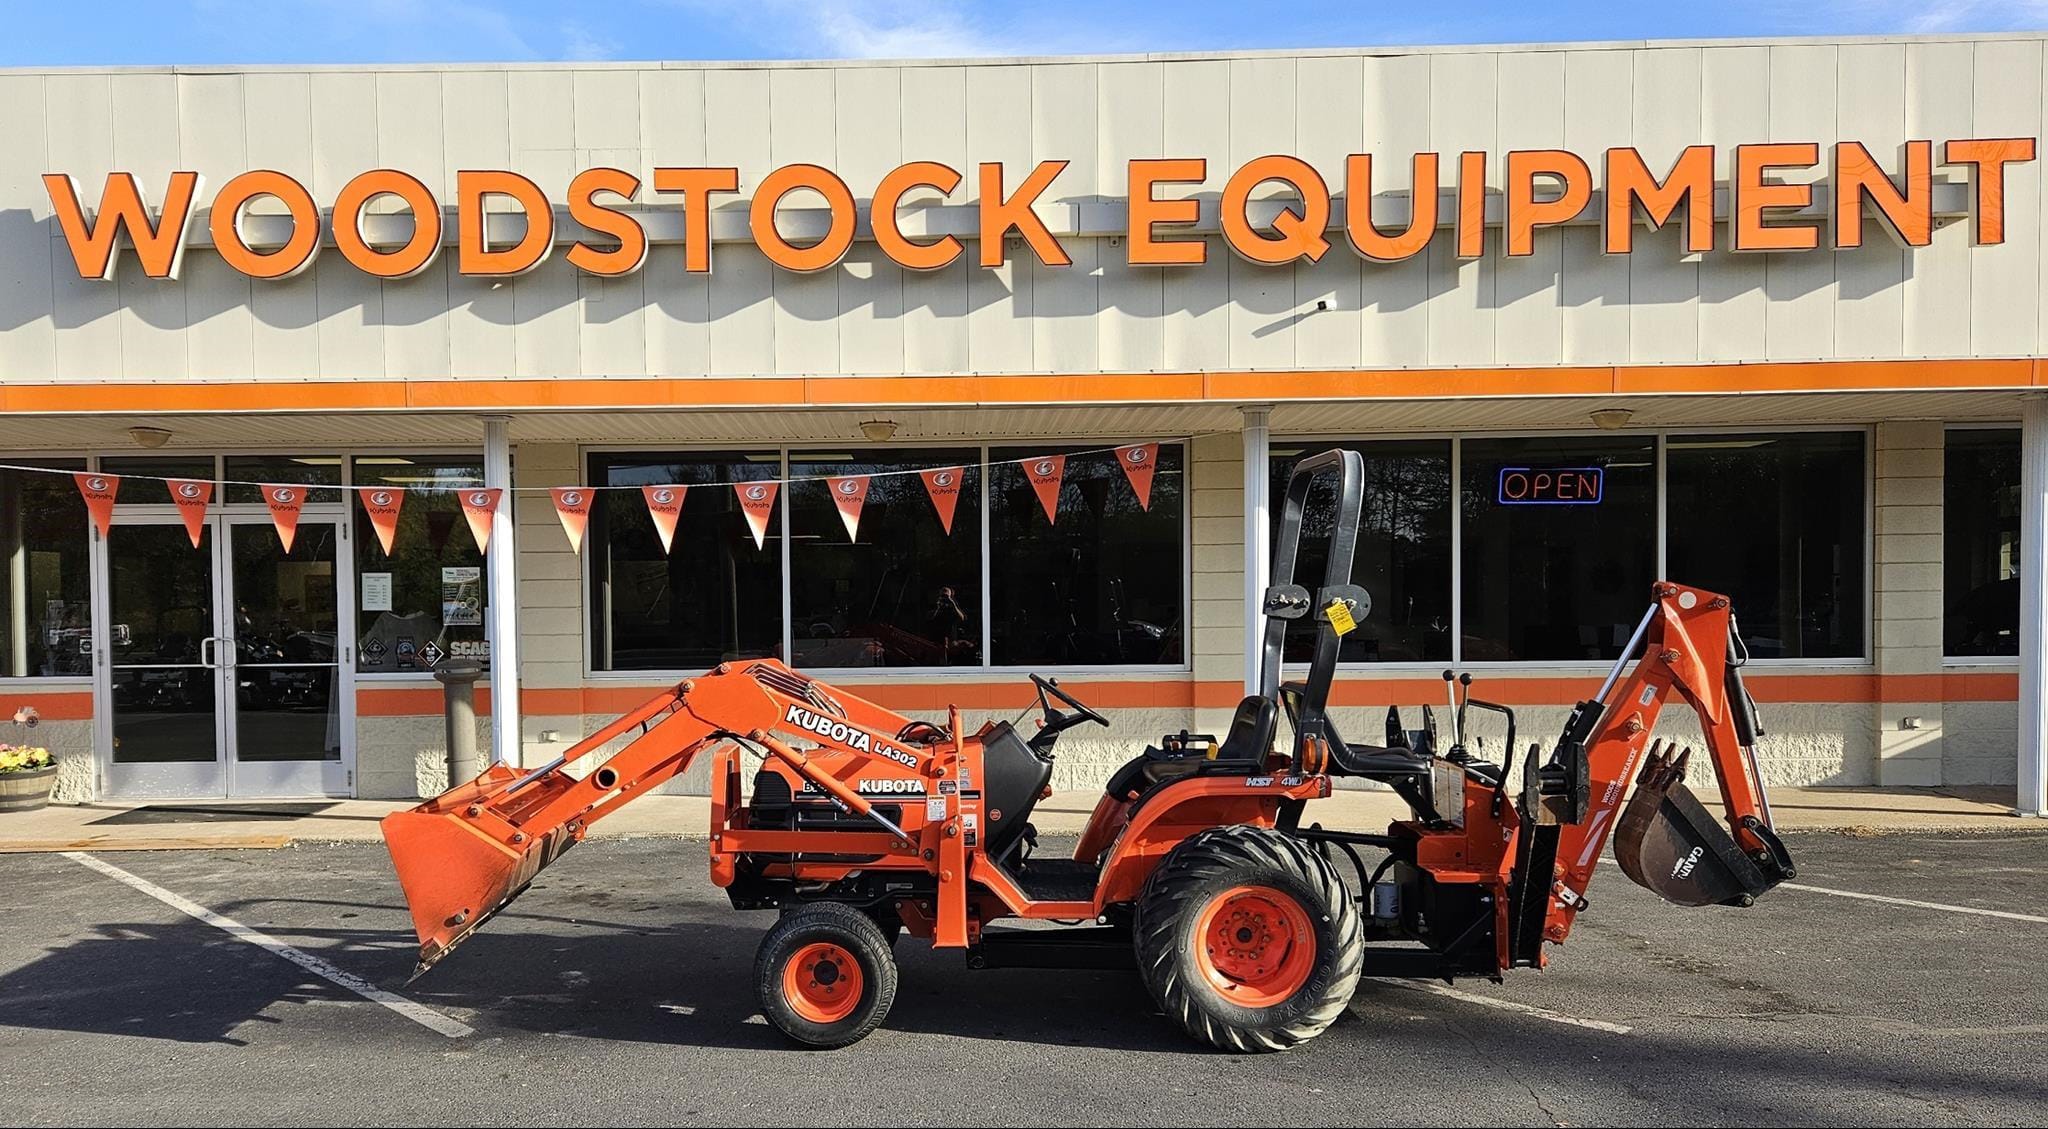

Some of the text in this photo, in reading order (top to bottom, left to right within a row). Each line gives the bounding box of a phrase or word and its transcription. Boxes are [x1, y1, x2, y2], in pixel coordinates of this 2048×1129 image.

[42, 137, 2036, 281] WOODSTOCK EQUIPMENT
[1126, 463, 1152, 472] Kubota
[1033, 476, 1060, 484] Kubota
[1505, 473, 1597, 499] OPEN
[85, 492, 113, 500] Kubota
[931, 488, 957, 496] Kubota
[177, 498, 205, 506] Kubota
[836, 495, 862, 503] Kubota
[270, 503, 298, 511] Kubota
[651, 504, 677, 512] Kubota
[744, 501, 770, 509] Kubota
[369, 506, 396, 514] Kubota
[559, 506, 586, 514] Kubota
[450, 641, 490, 656] SCAG
[786, 704, 918, 769] KUBOTA LA302
[1246, 777, 1302, 787] HST 4WD
[859, 780, 925, 793] KUBOTA
